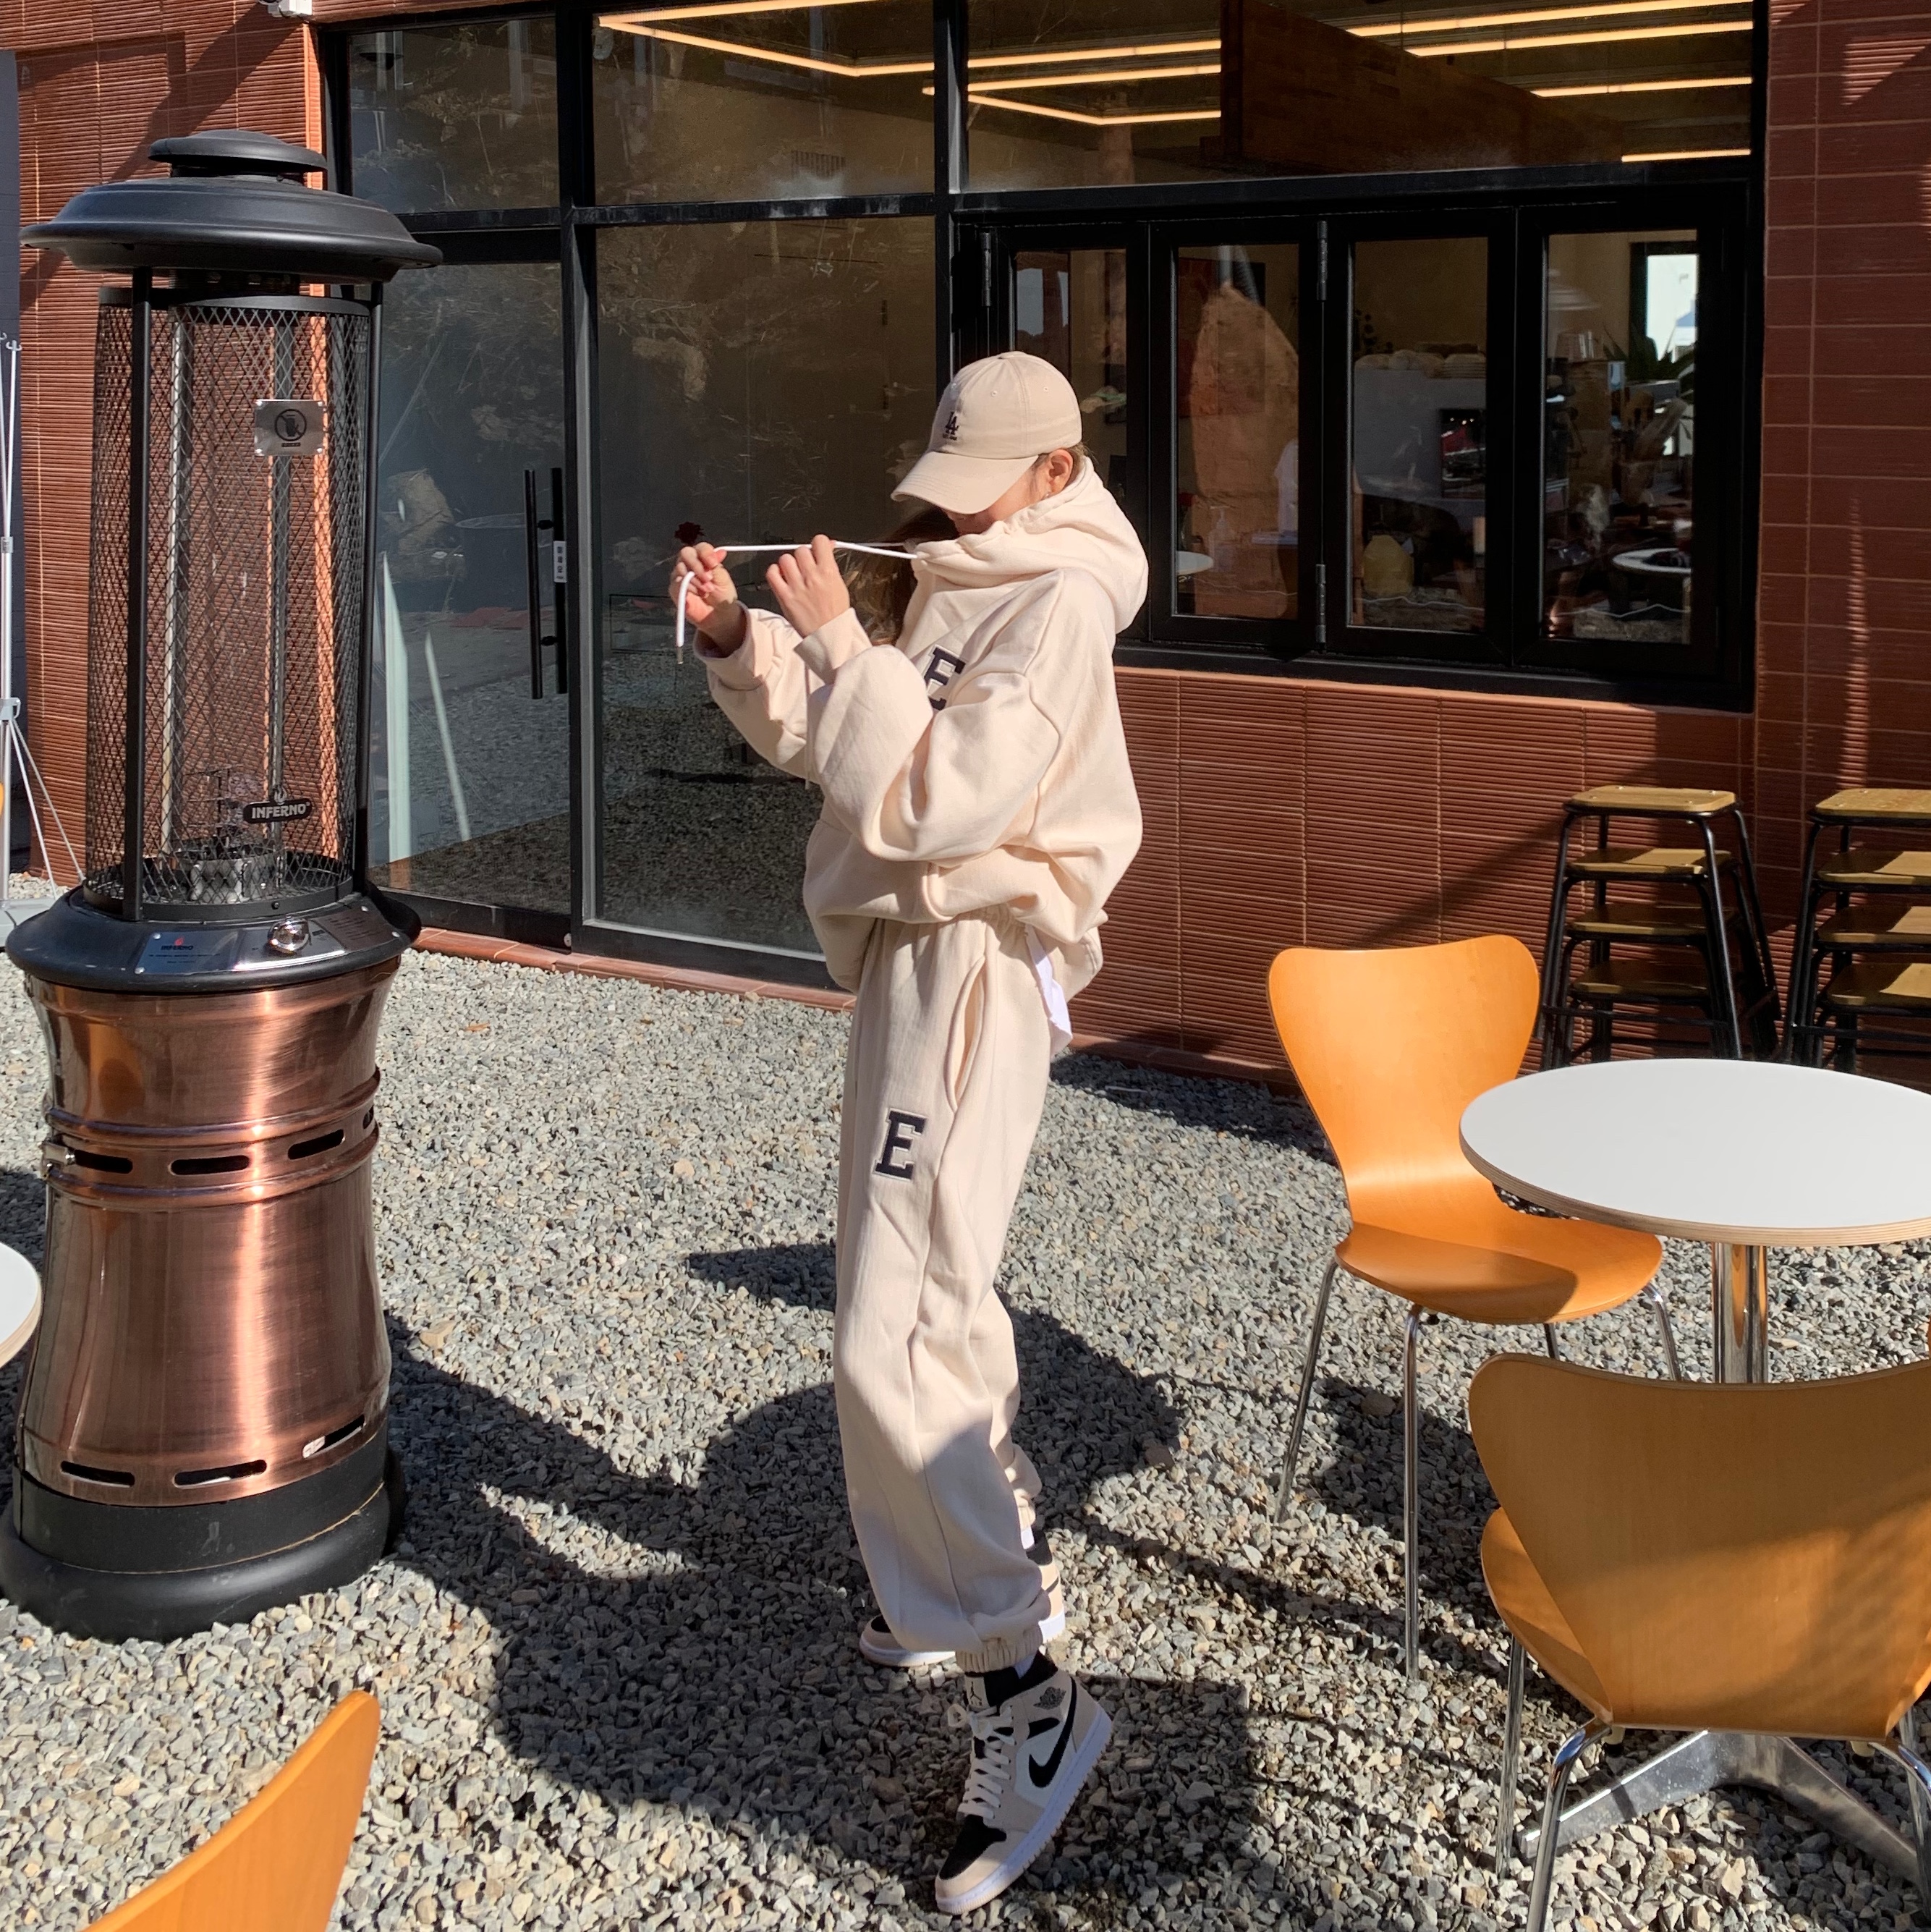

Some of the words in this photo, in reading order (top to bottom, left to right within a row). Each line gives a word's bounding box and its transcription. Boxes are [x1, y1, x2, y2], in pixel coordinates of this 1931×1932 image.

[944, 412, 959, 436] LA
[923, 645, 967, 711] E
[251, 803, 306, 819] INFERNO
[873, 1109, 928, 1181] E
